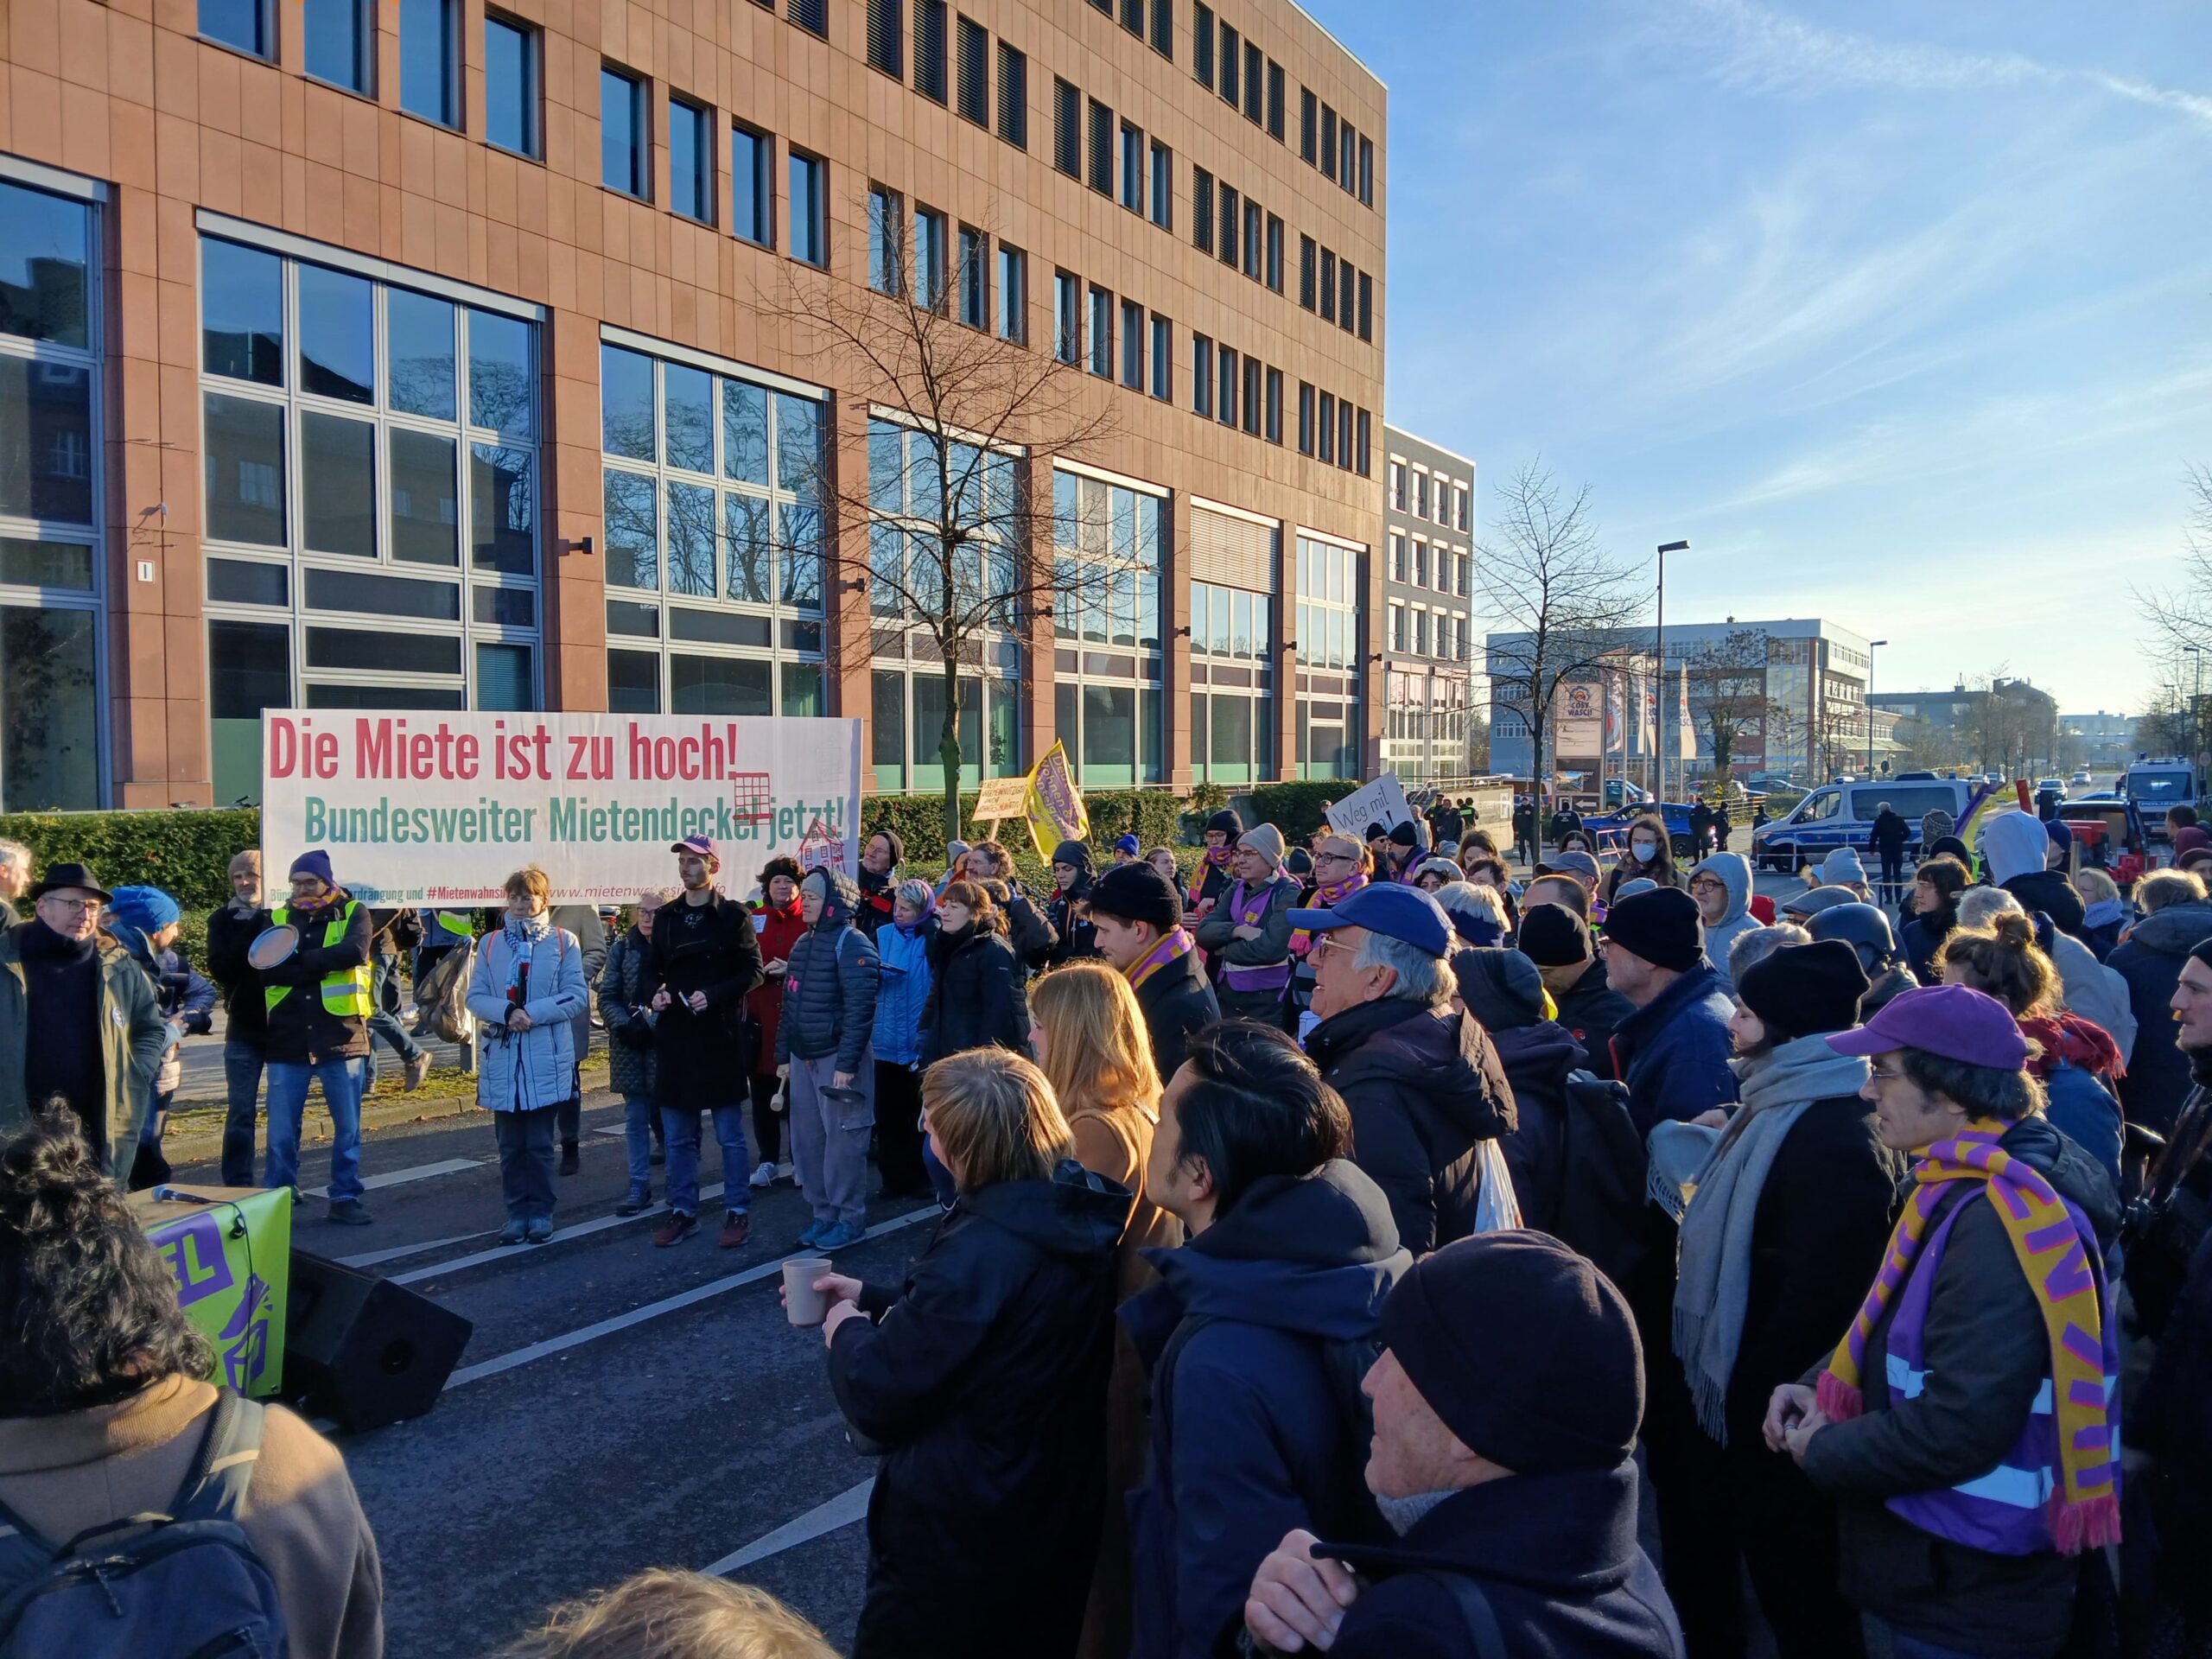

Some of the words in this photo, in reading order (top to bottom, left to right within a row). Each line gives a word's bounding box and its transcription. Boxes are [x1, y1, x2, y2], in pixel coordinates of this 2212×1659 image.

[270, 718, 338, 779] Die
[356, 719, 479, 779] Miete
[495, 721, 552, 780] ist
[567, 735, 613, 780] zu
[629, 722, 737, 781] hoch!
[305, 797, 537, 844] Bundesweiter
[550, 797, 759, 842] Mietendeckel
[766, 797, 844, 850] jetzt!
[1332, 801, 1368, 830] Weg
[1370, 784, 1389, 812] mit
[406, 887, 423, 900] und
